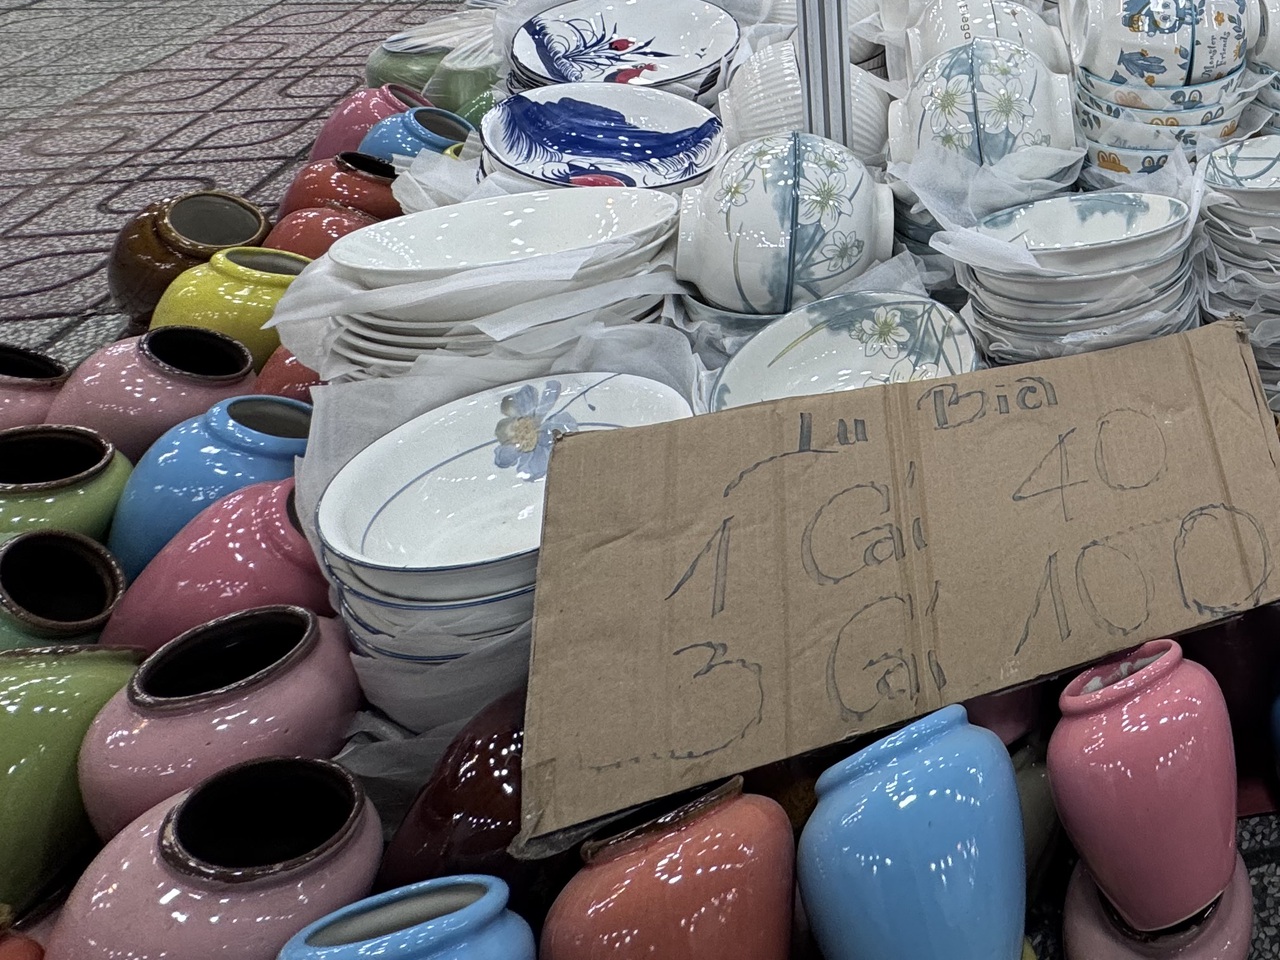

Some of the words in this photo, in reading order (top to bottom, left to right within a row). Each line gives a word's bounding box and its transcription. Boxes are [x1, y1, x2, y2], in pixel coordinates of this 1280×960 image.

[663, 515, 735, 618] 1
[1012, 407, 1169, 522] 40
[1014, 502, 1271, 656] 100
